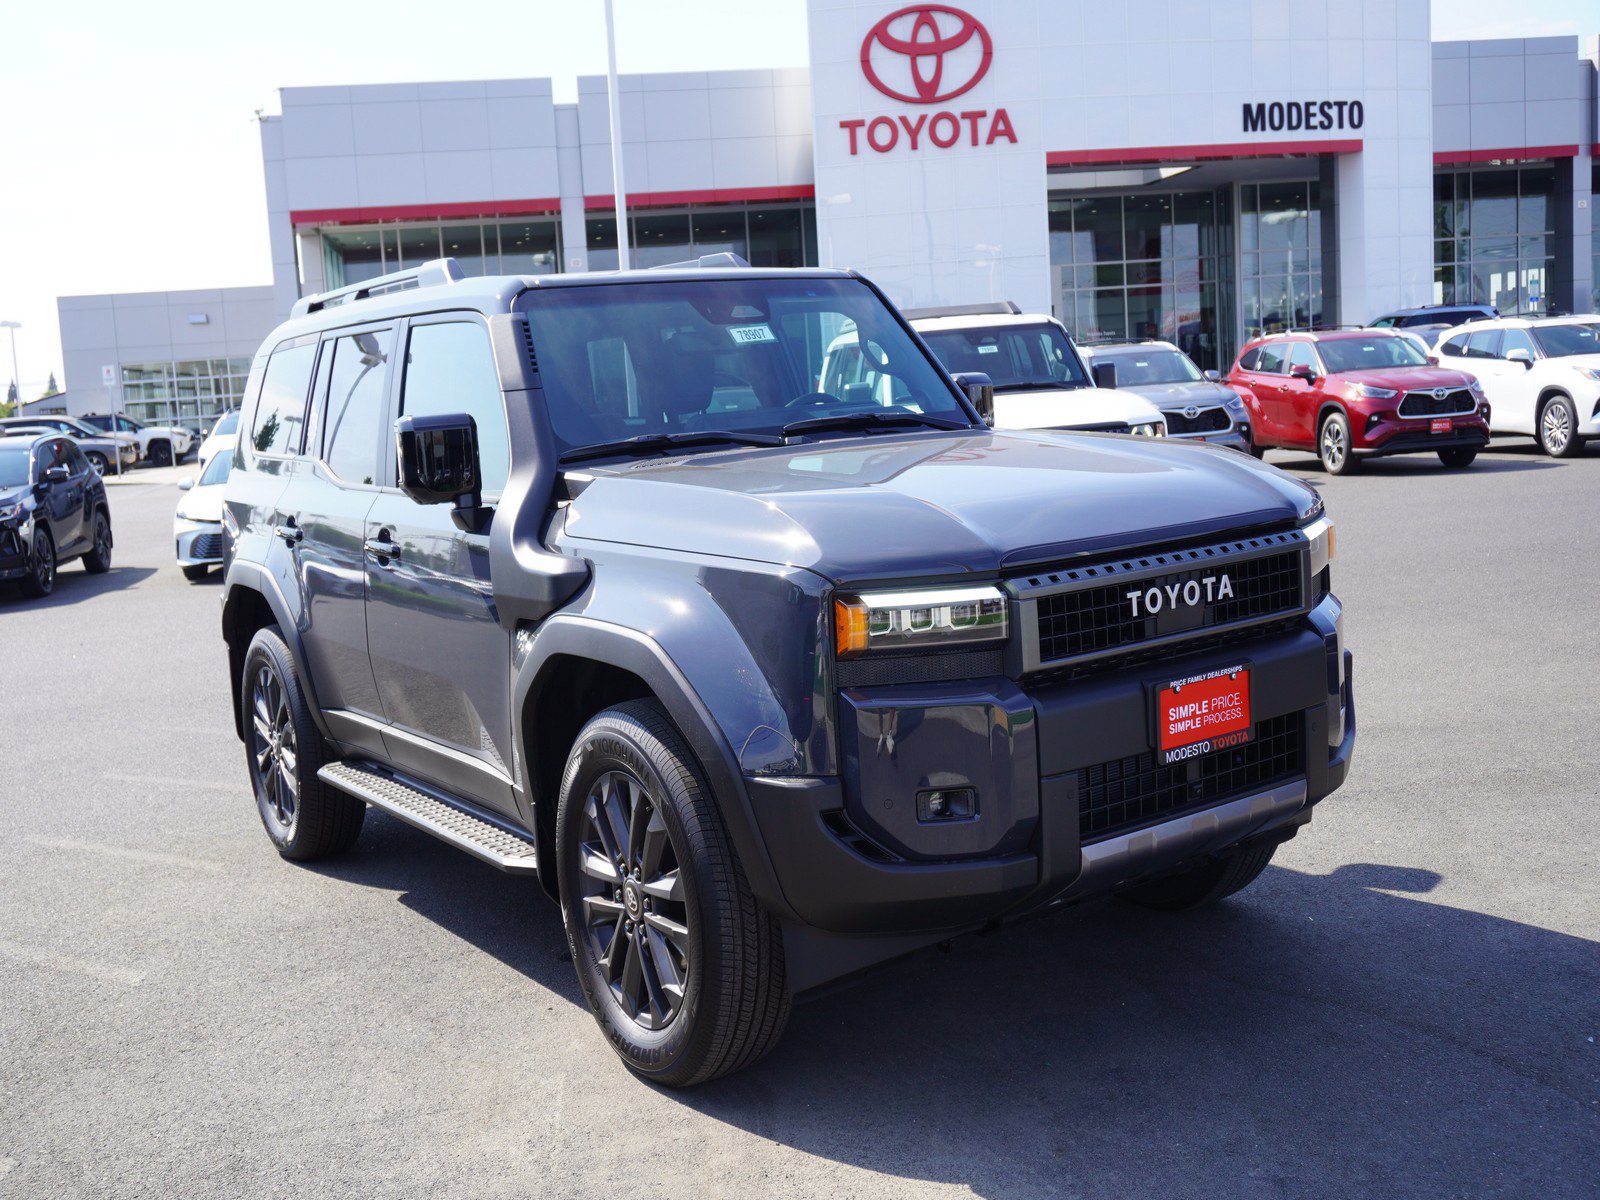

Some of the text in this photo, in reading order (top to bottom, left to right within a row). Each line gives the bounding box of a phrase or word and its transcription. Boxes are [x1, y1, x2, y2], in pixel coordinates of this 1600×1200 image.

[840, 108, 1018, 155] TOYOTA
[1243, 100, 1364, 133] MODESTO
[736, 328, 766, 341] 78907
[1126, 574, 1234, 617] TOYOTA
[1170, 665, 1243, 688] PRICE FAMILY DEALERSHIPS
[1169, 692, 1243, 721] SIMPLE PRICE.
[1169, 707, 1244, 735] SIMPLE PROCESS.
[596, 738, 650, 787] YOKOHAMA
[1166, 731, 1249, 764] MODESTO TOYOTA
